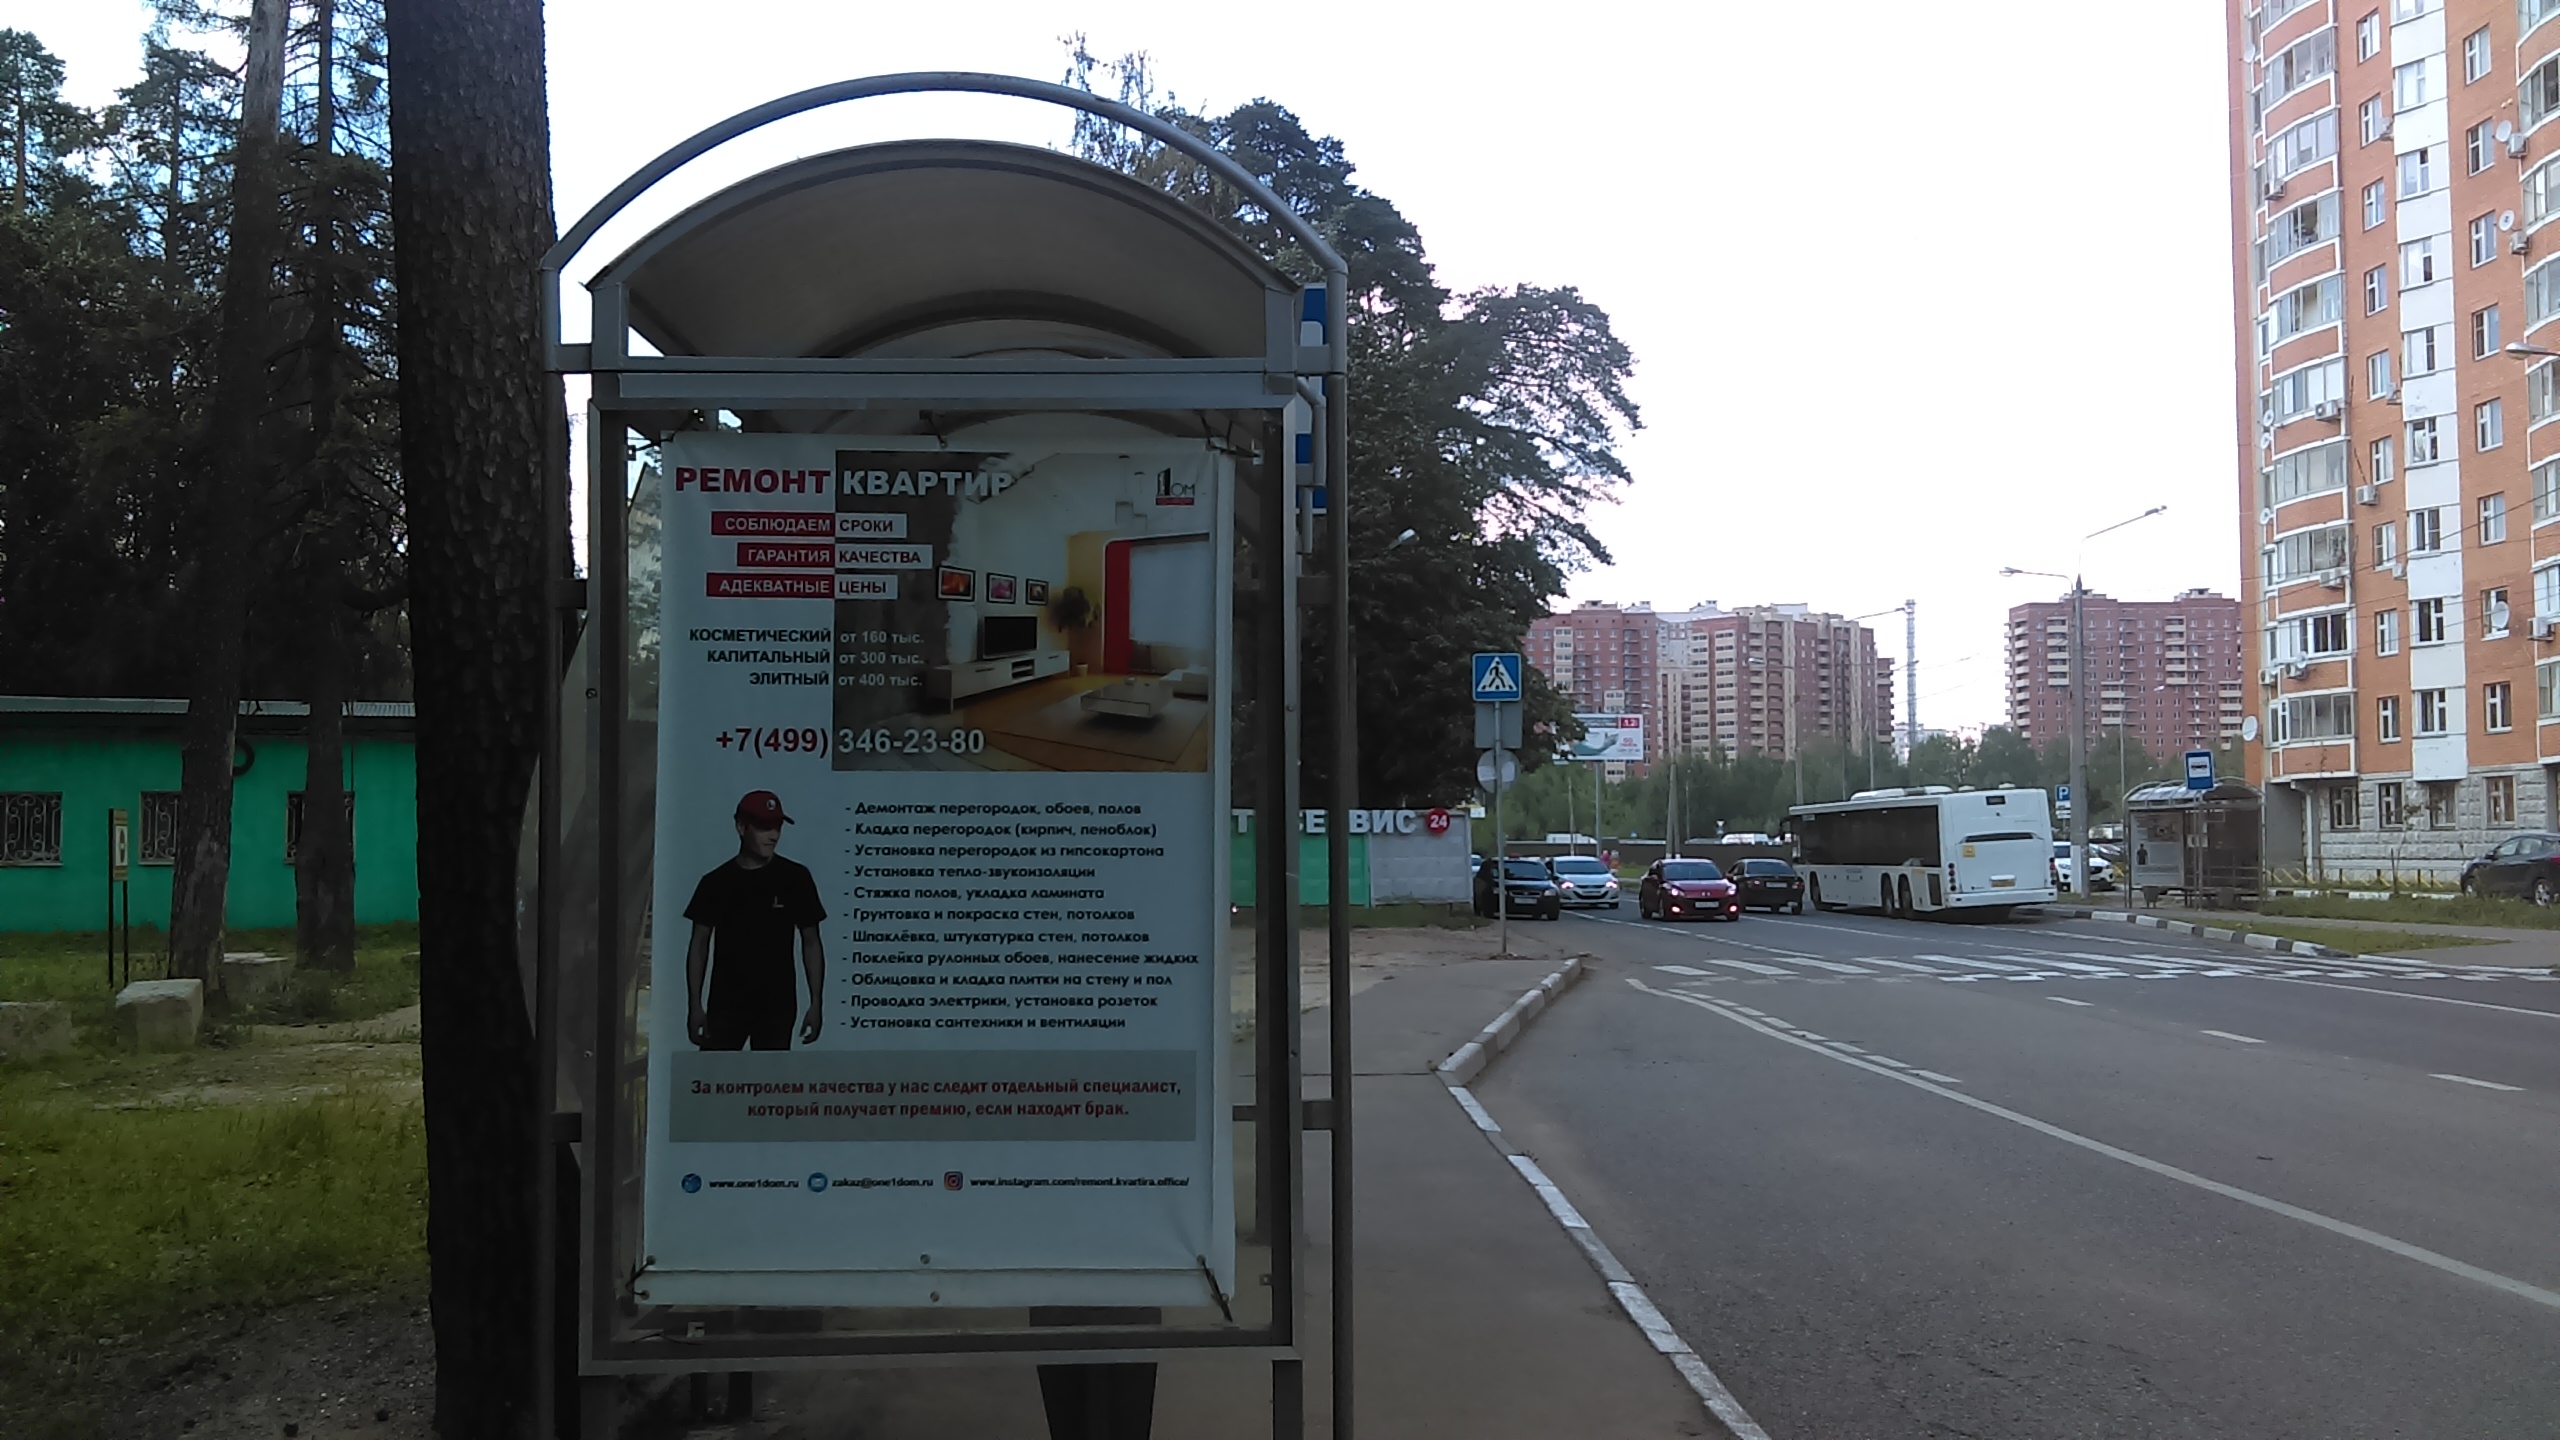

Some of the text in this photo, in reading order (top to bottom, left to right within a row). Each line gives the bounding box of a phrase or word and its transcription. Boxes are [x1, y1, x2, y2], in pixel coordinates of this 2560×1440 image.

[675, 467, 1015, 497] РЕМОНТ КВАРТИР
[725, 518, 893, 533] СОБЛЮДАЕМ СРОКИ
[748, 549, 921, 564] ГАРАНТИЯ КАЧЕСТВА
[720, 579, 887, 595] АДЕКВАТНЫЕ ЦЕНЫ
[689, 628, 924, 643] КОСМЕТИЧЕСКИЙ от 160 тыс.
[707, 649, 923, 664] КАПИТАЛЬНЫЙ от 300 тыс.
[749, 671, 922, 686] ЭЛИТНЫЙ от 400 тыс.
[716, 728, 985, 759] +7(499) 346-23-80
[855, 802, 1141, 816] Демонтаж перегородок, обоев, полов
[1430, 814, 1448, 829] 24
[855, 823, 1157, 838] Кладка перегородок (кирпич, пеноблок)
[854, 844, 1164, 859] Установка перегородок из гипсокартона
[854, 865, 1095, 880] Установка тепло-звукоизоляции
[853, 886, 1104, 901] Стяжка полов, укладка ламината
[853, 908, 1135, 922] Грунтовка и покраска стен, потолков
[943, 932, 1034, 945] штукатурка
[1038, 932, 1077, 943] стен,
[1081, 932, 1149, 942] потолков
[851, 951, 1199, 966] Поклейка рулонных обоев, нанесение жидких
[851, 973, 1173, 988] Облицовка и кладка плитки на стену и пол
[851, 995, 1158, 1009] Проводка электрики, установка розеток
[850, 1016, 1126, 1029] Установка сантехники и вентиляции
[691, 1079, 1181, 1097] За контролем качества у нас следит отдельный специалист,
[748, 1101, 1129, 1119] который получает премию, если находит брак.
